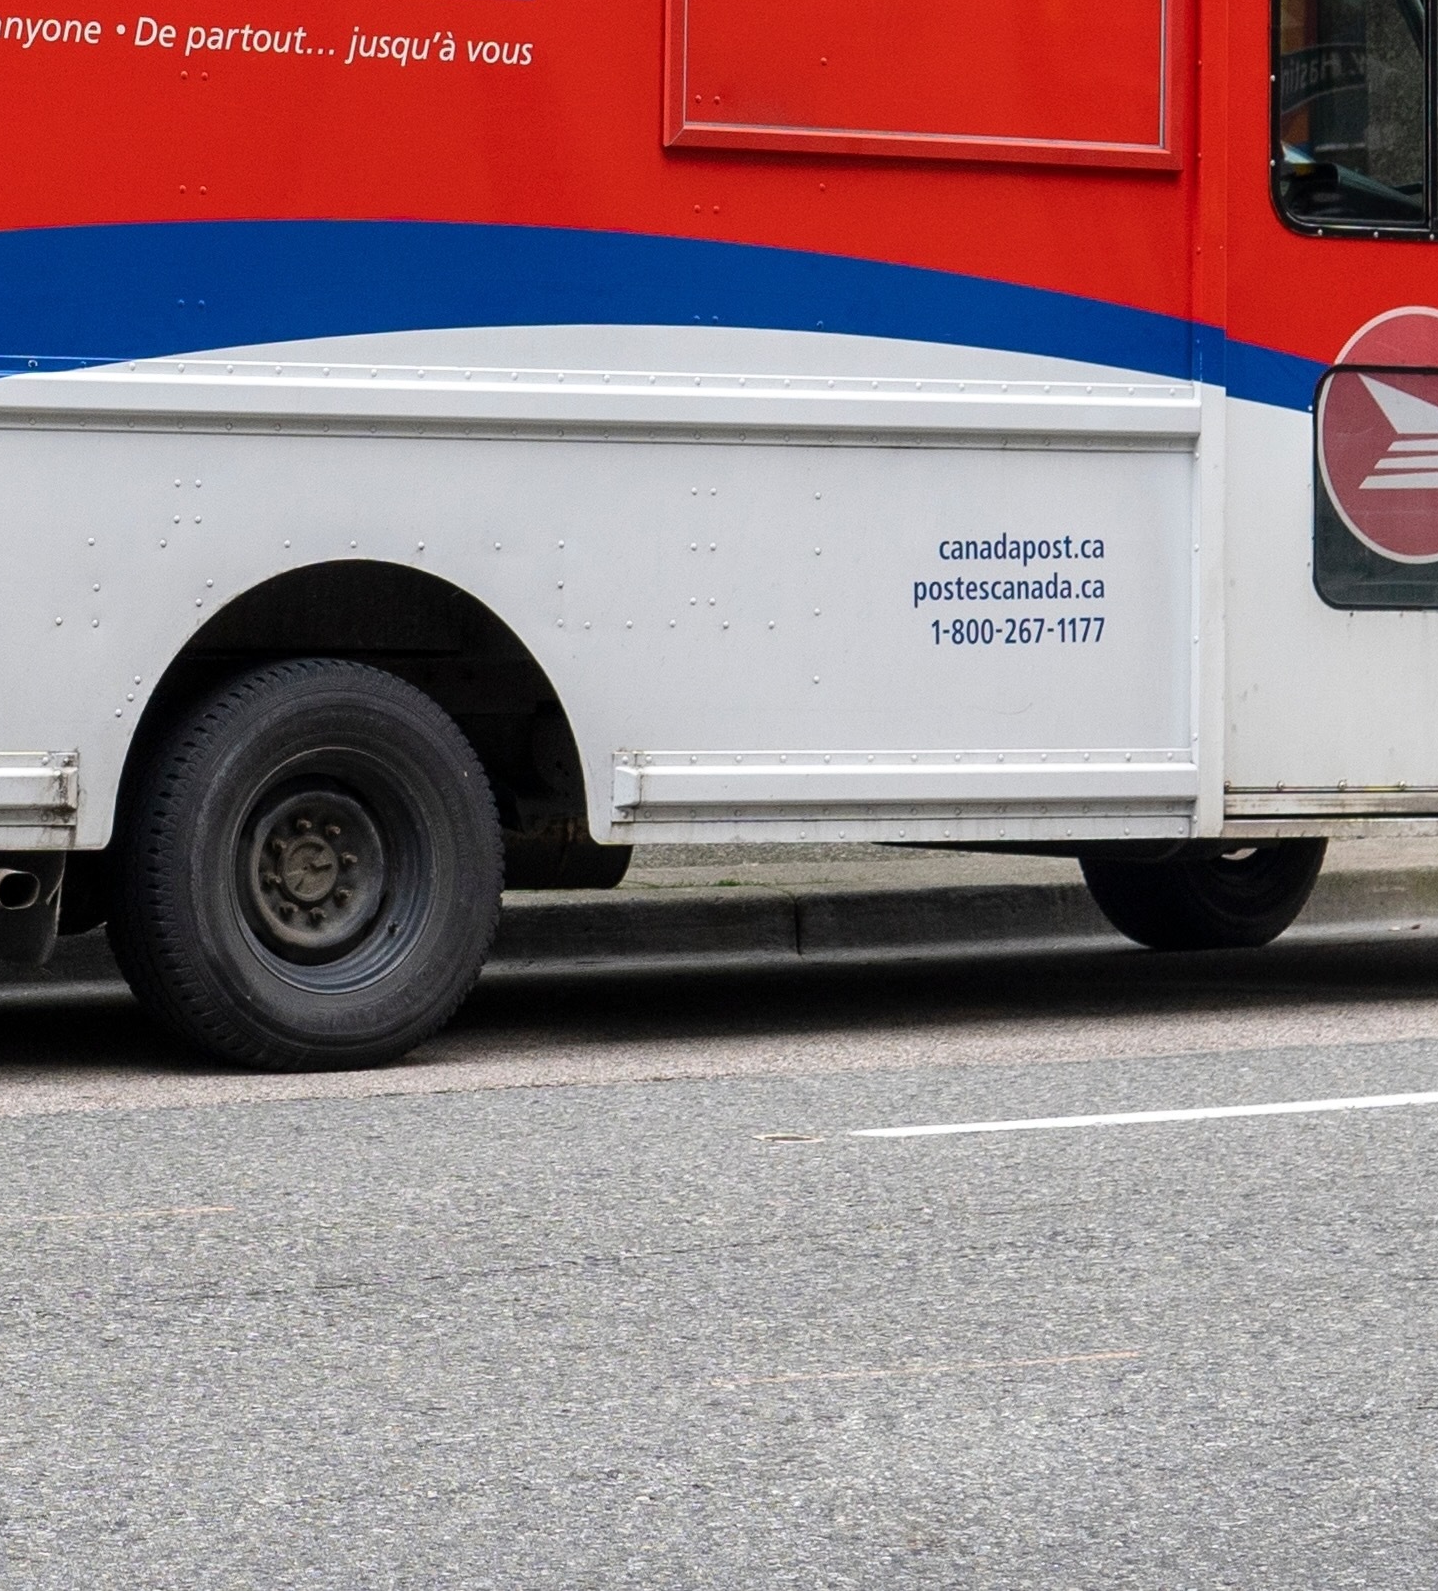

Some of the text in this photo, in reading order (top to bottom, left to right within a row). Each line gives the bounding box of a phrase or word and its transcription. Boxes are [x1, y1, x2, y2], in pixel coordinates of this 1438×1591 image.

[134, 16, 177, 49] De
[185, 23, 335, 58] partout...
[467, 38, 534, 66] vous
[939, 532, 1105, 567] canadapost.ca
[913, 572, 1105, 608] postescanada.ca
[931, 617, 1105, 645] 1-800-267-1177
